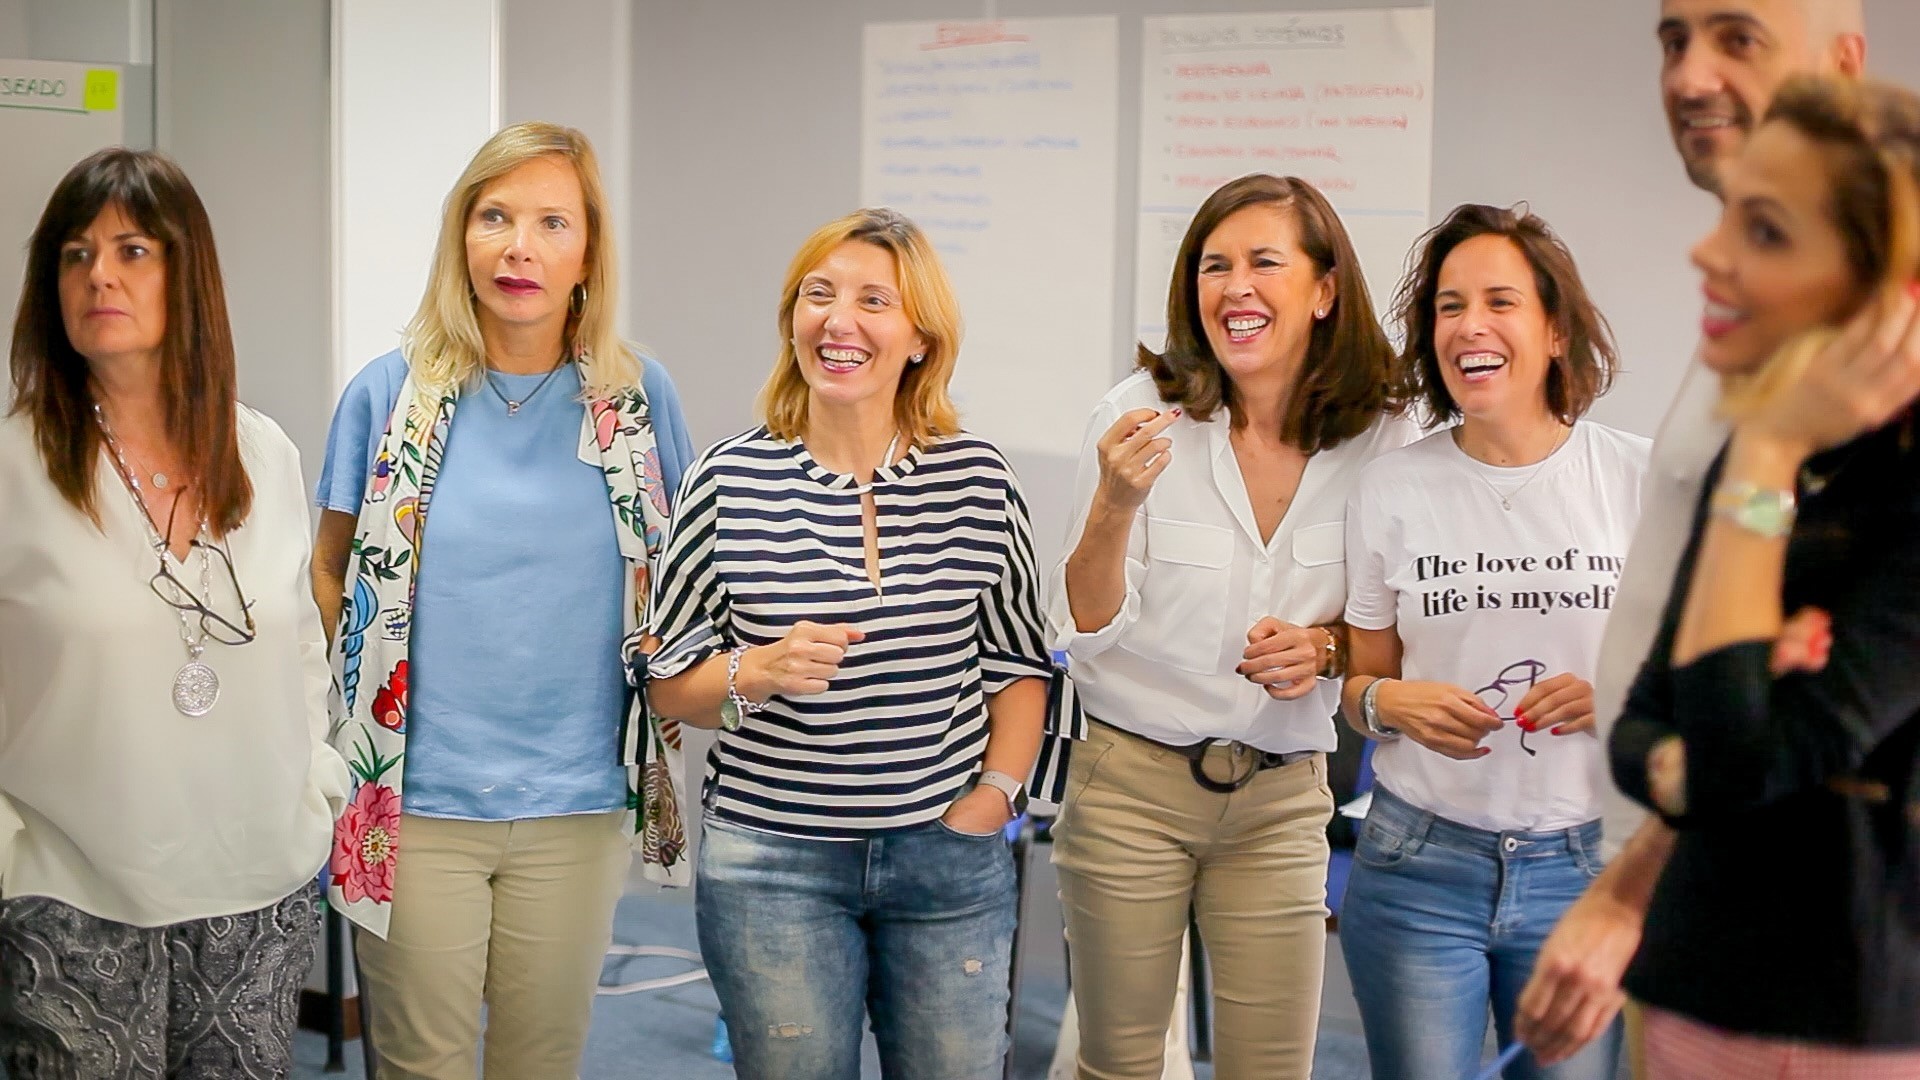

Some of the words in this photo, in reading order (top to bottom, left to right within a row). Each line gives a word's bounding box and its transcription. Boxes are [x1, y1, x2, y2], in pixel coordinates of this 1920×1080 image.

[1411, 554, 1468, 582] The
[1475, 552, 1538, 573] love
[1545, 547, 1580, 571] of
[1586, 554, 1625, 580] my
[1421, 587, 1469, 618] life
[1475, 584, 1502, 610] is
[1510, 584, 1616, 615] myself
